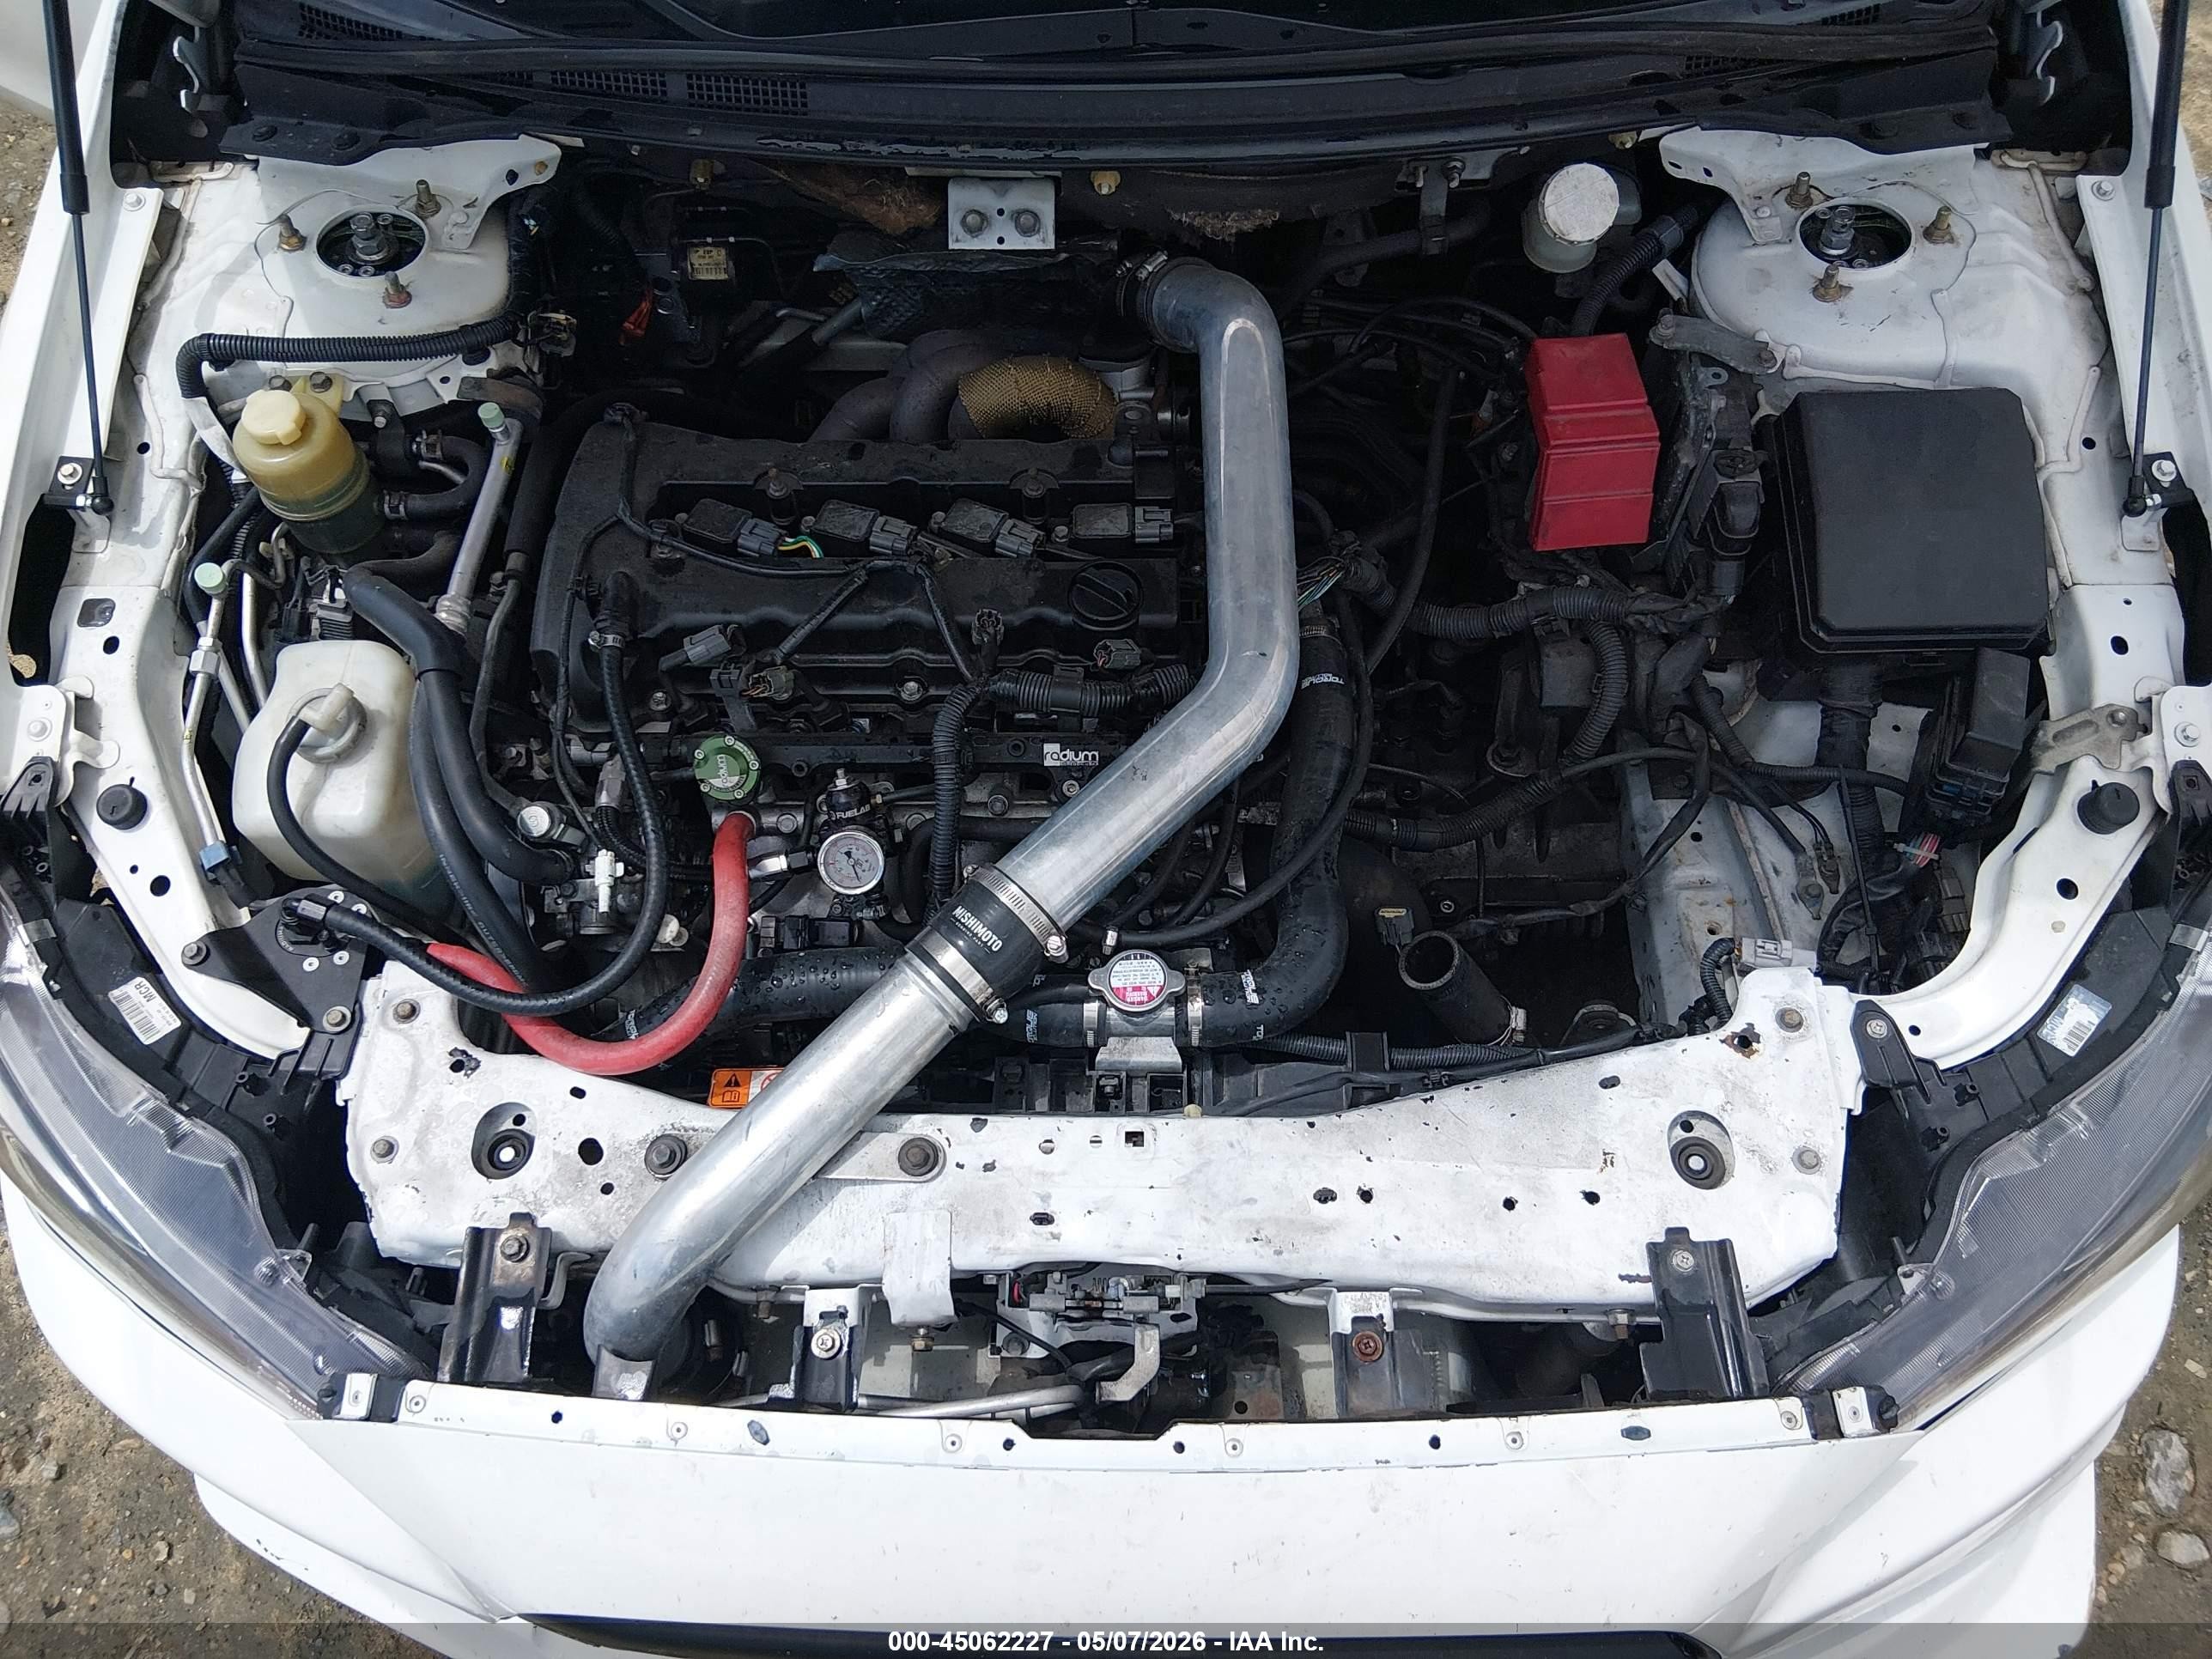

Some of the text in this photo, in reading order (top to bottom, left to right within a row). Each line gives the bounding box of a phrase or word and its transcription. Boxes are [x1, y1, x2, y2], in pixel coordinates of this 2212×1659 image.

[1044, 748, 1099, 762] radium
[836, 804, 871, 820] FUELAB
[951, 905, 1003, 952] MISHIMOTO
[134, 981, 157, 1003] MCR
